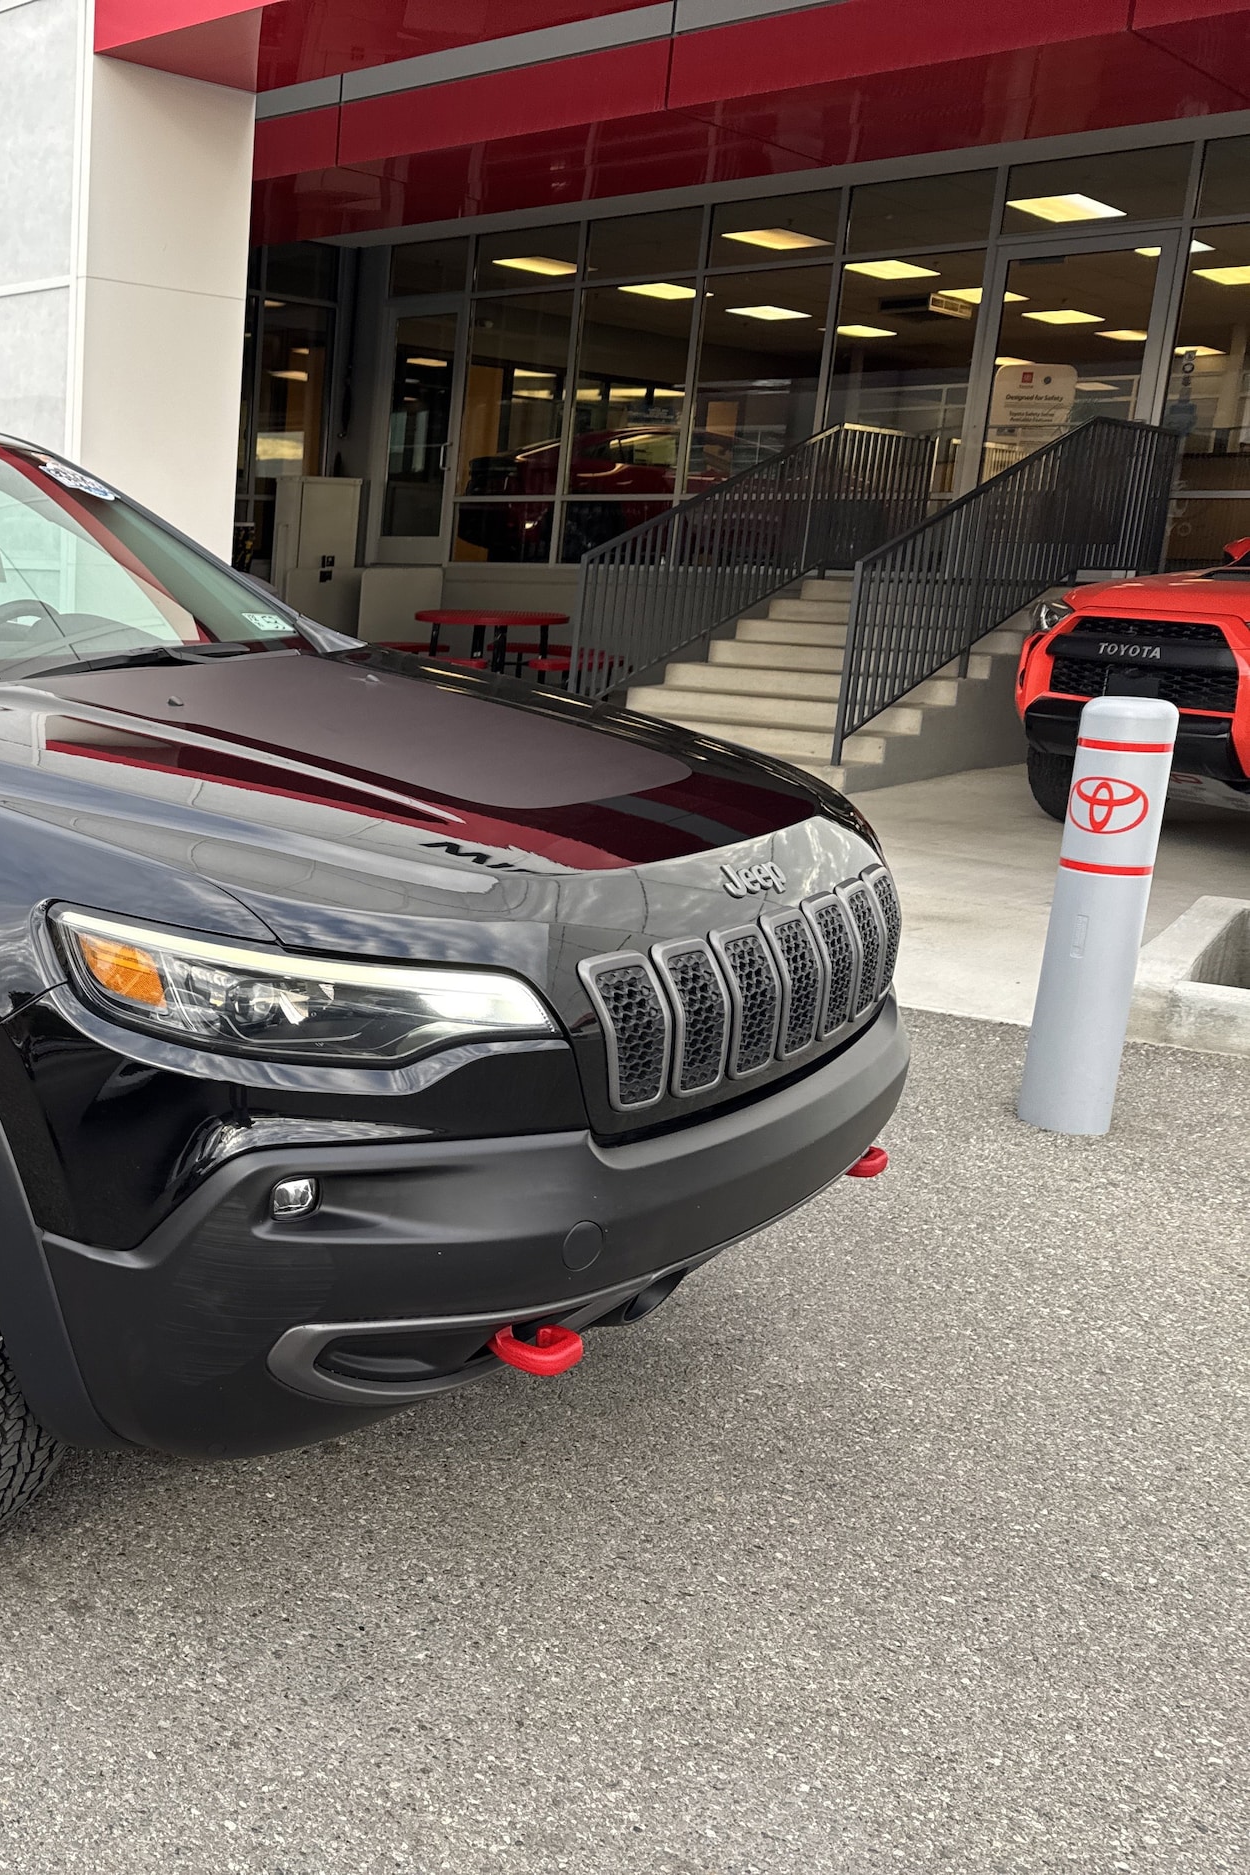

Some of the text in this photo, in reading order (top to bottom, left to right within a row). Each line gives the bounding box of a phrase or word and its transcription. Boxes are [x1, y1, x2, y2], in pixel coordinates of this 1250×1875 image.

[1005, 394, 1034, 402] Designed
[1044, 394, 1064, 402] Safety
[1098, 642, 1161, 659] TOYOTA
[720, 861, 787, 899] Jeep
